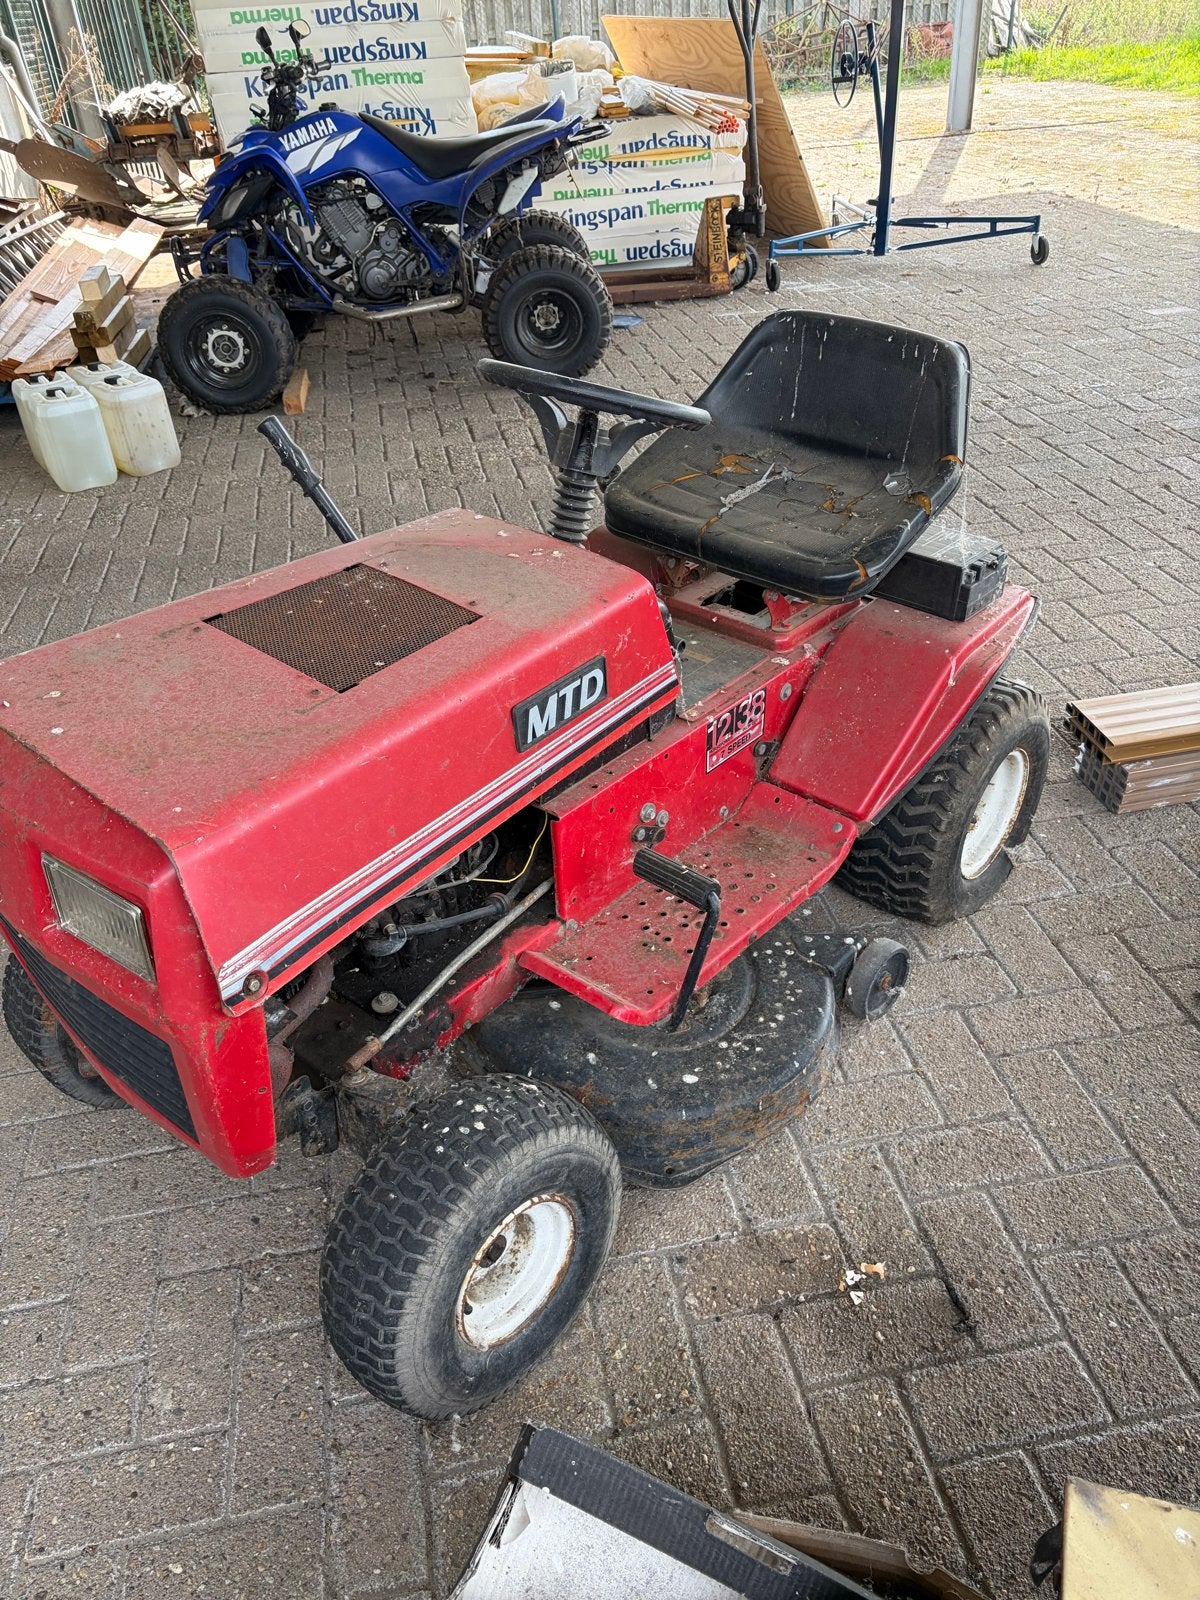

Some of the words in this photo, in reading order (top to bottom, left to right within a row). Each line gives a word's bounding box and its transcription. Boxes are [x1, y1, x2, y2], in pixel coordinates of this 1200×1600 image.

[314, 0, 419, 25] Kingspan
[241, 48, 311, 64] herma
[324, 37, 427, 63] Kingspan
[244, 73, 348, 99] Kspan
[351, 68, 425, 86] Therma
[278, 117, 338, 151] YAMAHA
[711, 205, 723, 263] STEINBOCK
[591, 248, 617, 264] The
[626, 238, 693, 261] ngspan
[527, 668, 604, 744] MTD
[727, 733, 751, 755] SPEED
